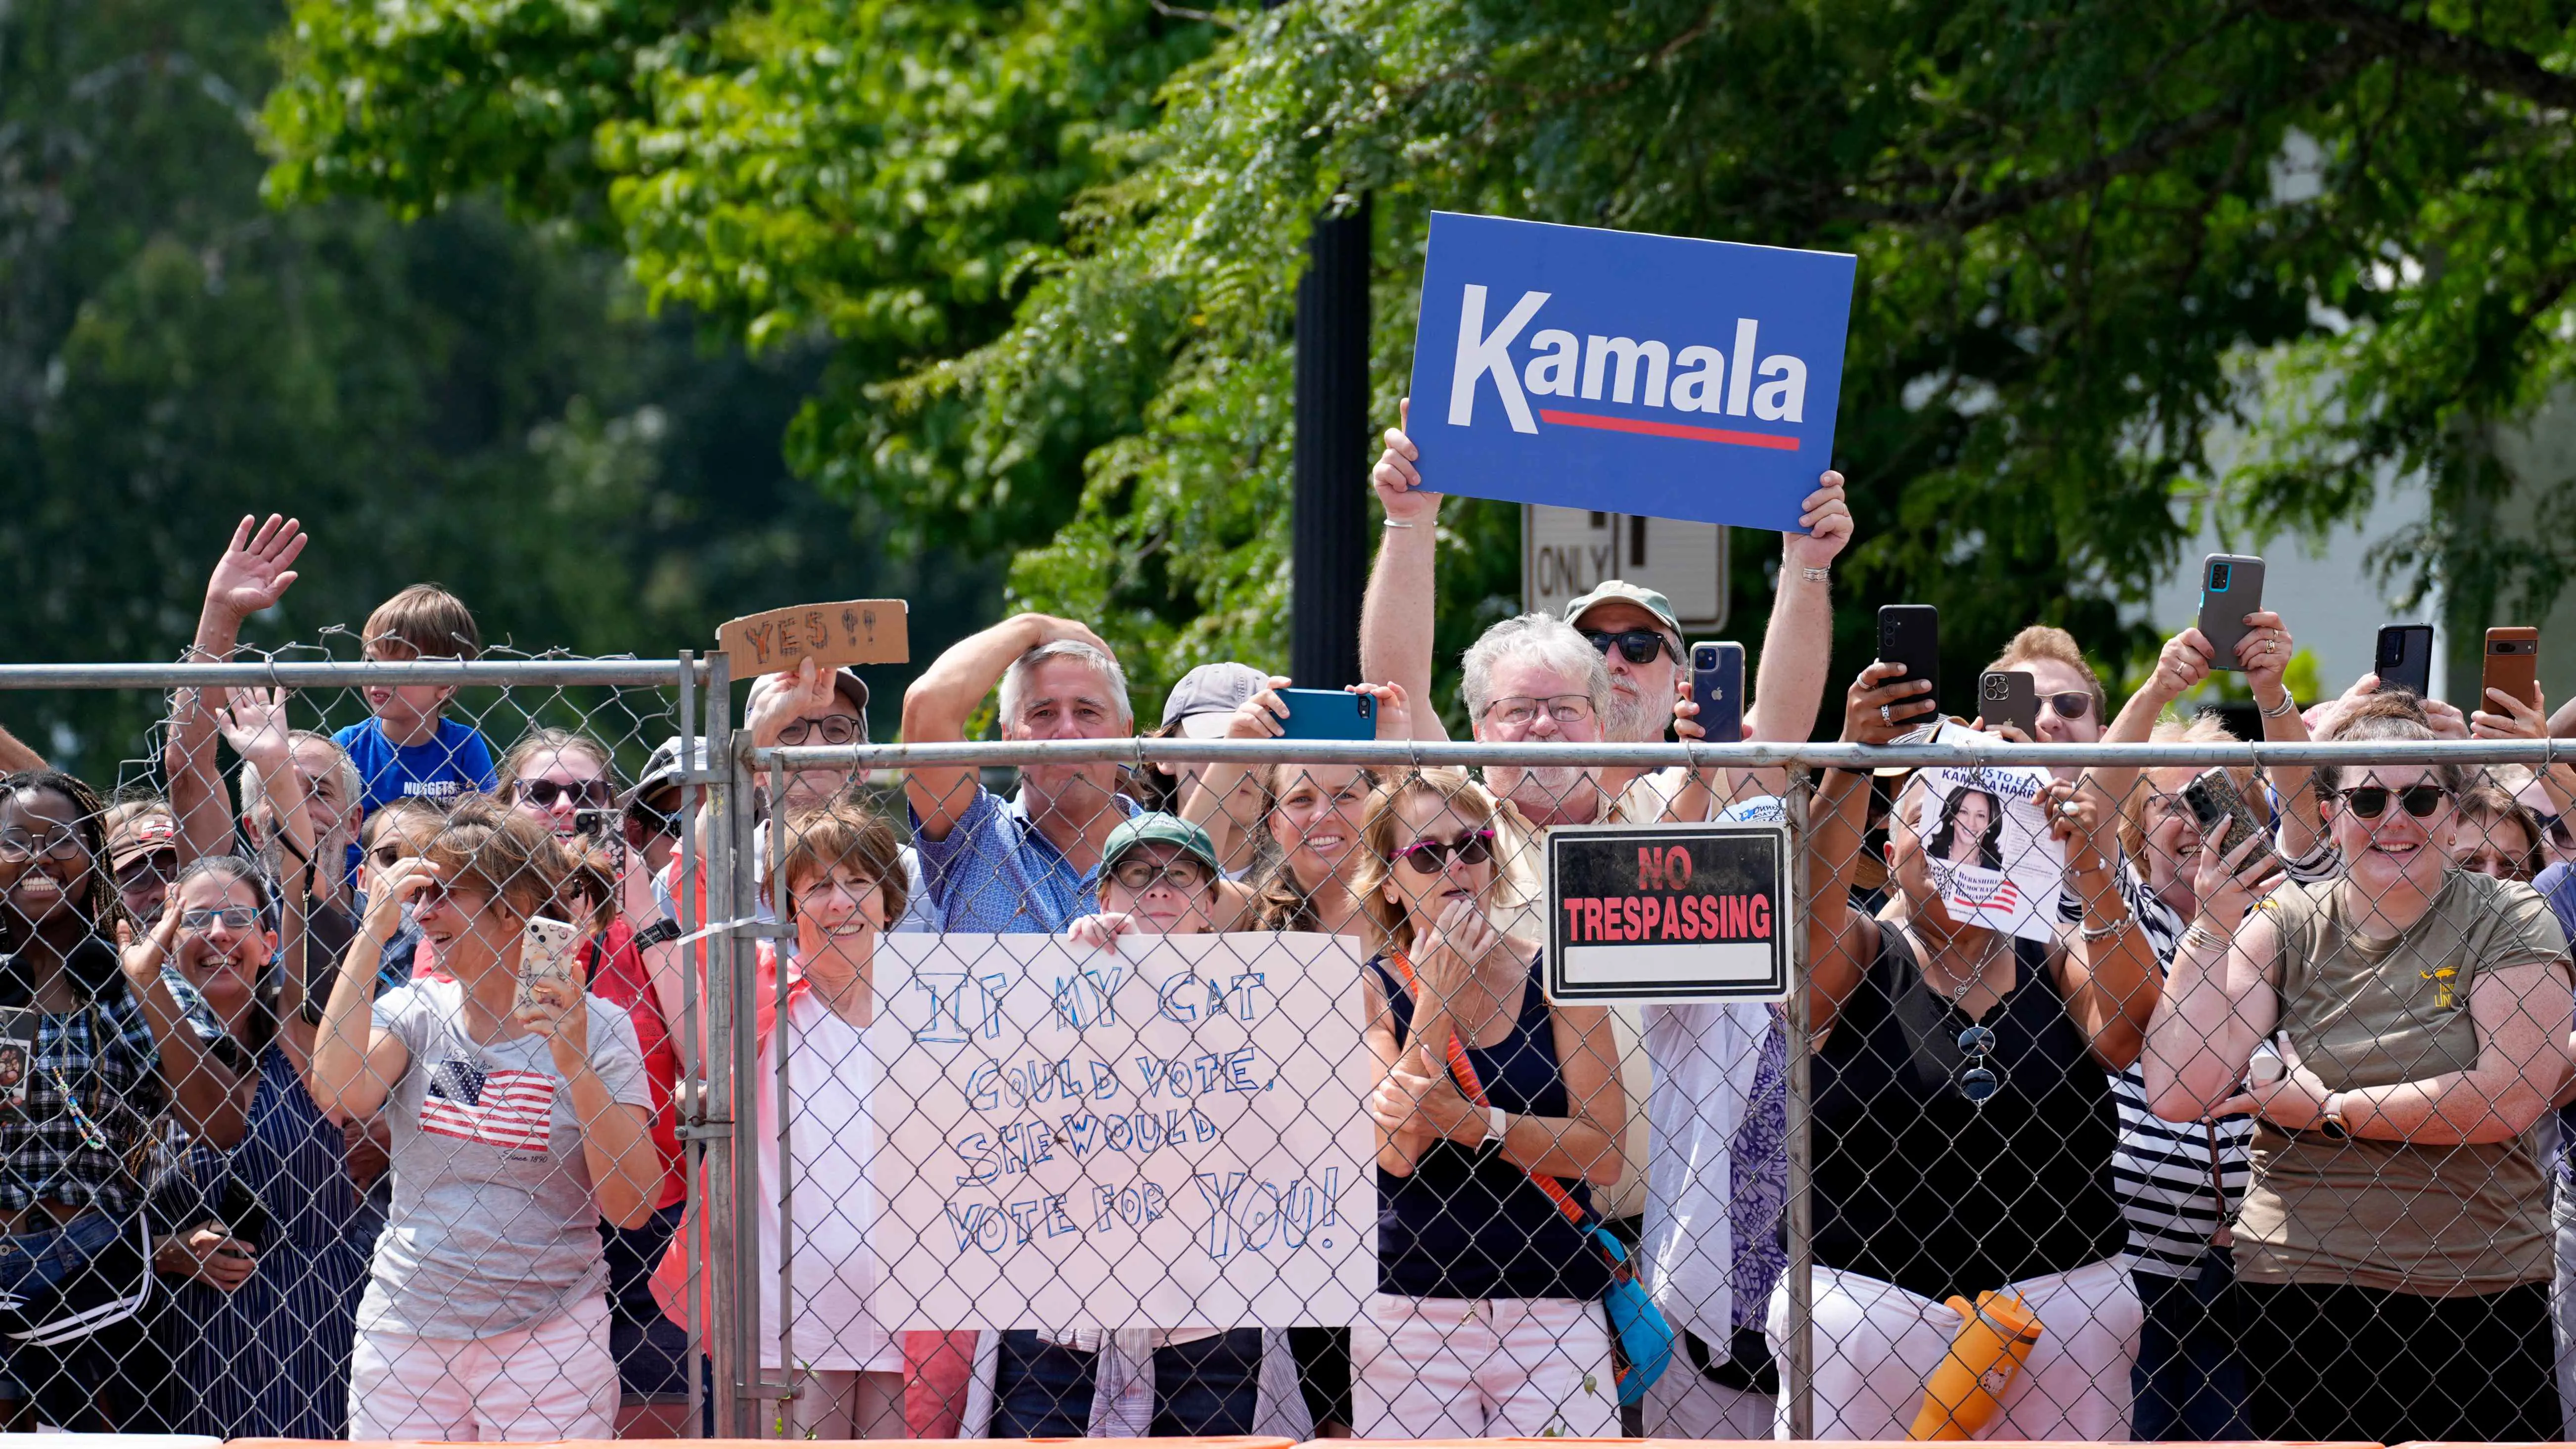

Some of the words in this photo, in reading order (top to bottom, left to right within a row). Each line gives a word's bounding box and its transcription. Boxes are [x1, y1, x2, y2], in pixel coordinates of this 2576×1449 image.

[1447, 283, 1807, 435] Kamala
[1537, 545, 1610, 596] ONLY
[1996, 770, 2013, 782] TO
[2000, 782, 2036, 799] HARR
[1638, 845, 1693, 890] NO
[1564, 893, 1770, 942] TRESPASSING
[911, 972, 1007, 1043] IF
[1054, 966, 1123, 1032] MY
[1157, 971, 1265, 1024] CAT
[965, 1058, 1119, 1111] COULD
[955, 1121, 1054, 1187] SHE
[1060, 1108, 1216, 1158] WOULD
[946, 1193, 1076, 1254] VOTE
[1092, 1182, 1165, 1232] FOR
[1193, 1166, 1338, 1260] YOU!
